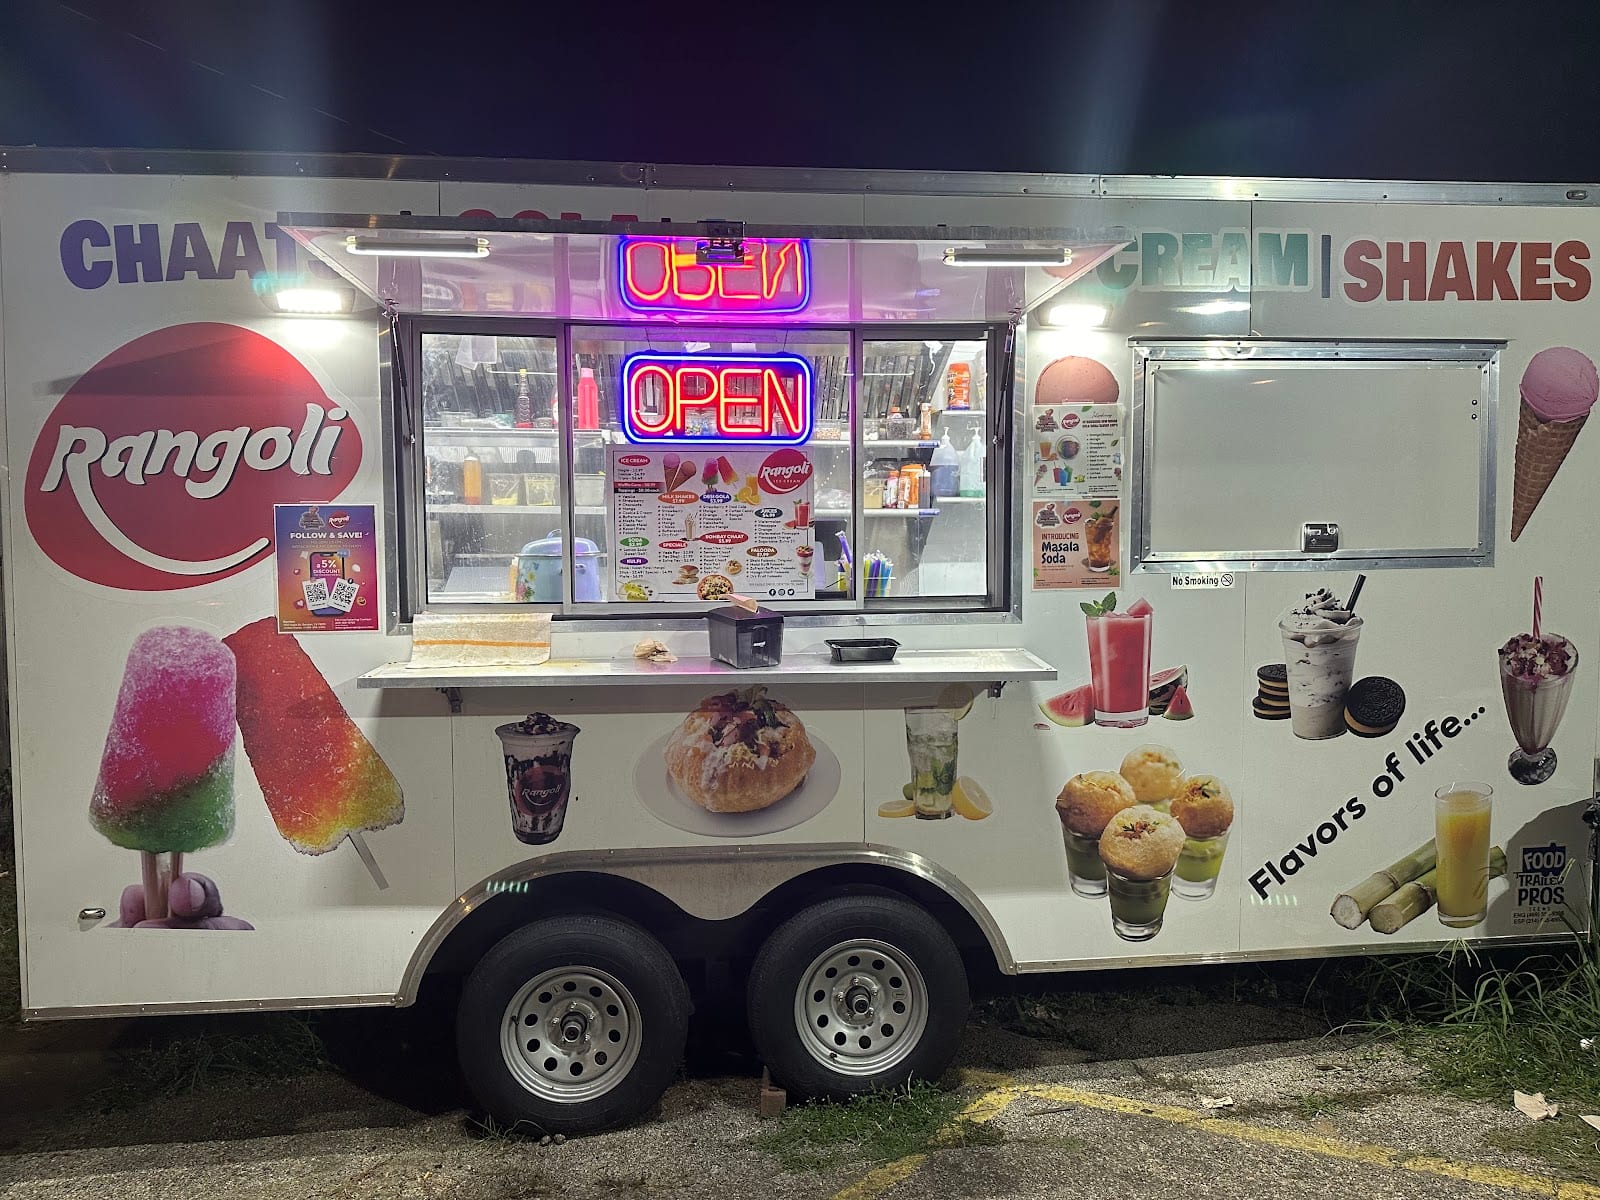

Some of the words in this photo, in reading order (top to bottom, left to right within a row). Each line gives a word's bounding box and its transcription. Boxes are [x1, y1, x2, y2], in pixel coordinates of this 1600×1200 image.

[1096, 232, 1309, 290] CREAM
[1343, 240, 1592, 302] SHAKES
[631, 365, 802, 433] OPEN
[1041, 542, 1079, 552] Masala
[321, 560, 337, 568] 5%
[1041, 553, 1066, 564] Soda
[1172, 576, 1183, 586] No
[1185, 574, 1219, 587] Smoking
[1248, 796, 1367, 900] Flavors
[1372, 752, 1405, 799] of
[1405, 706, 1486, 765] life...
[1523, 852, 1565, 870] FOOD
[1518, 887, 1565, 906] PROS
